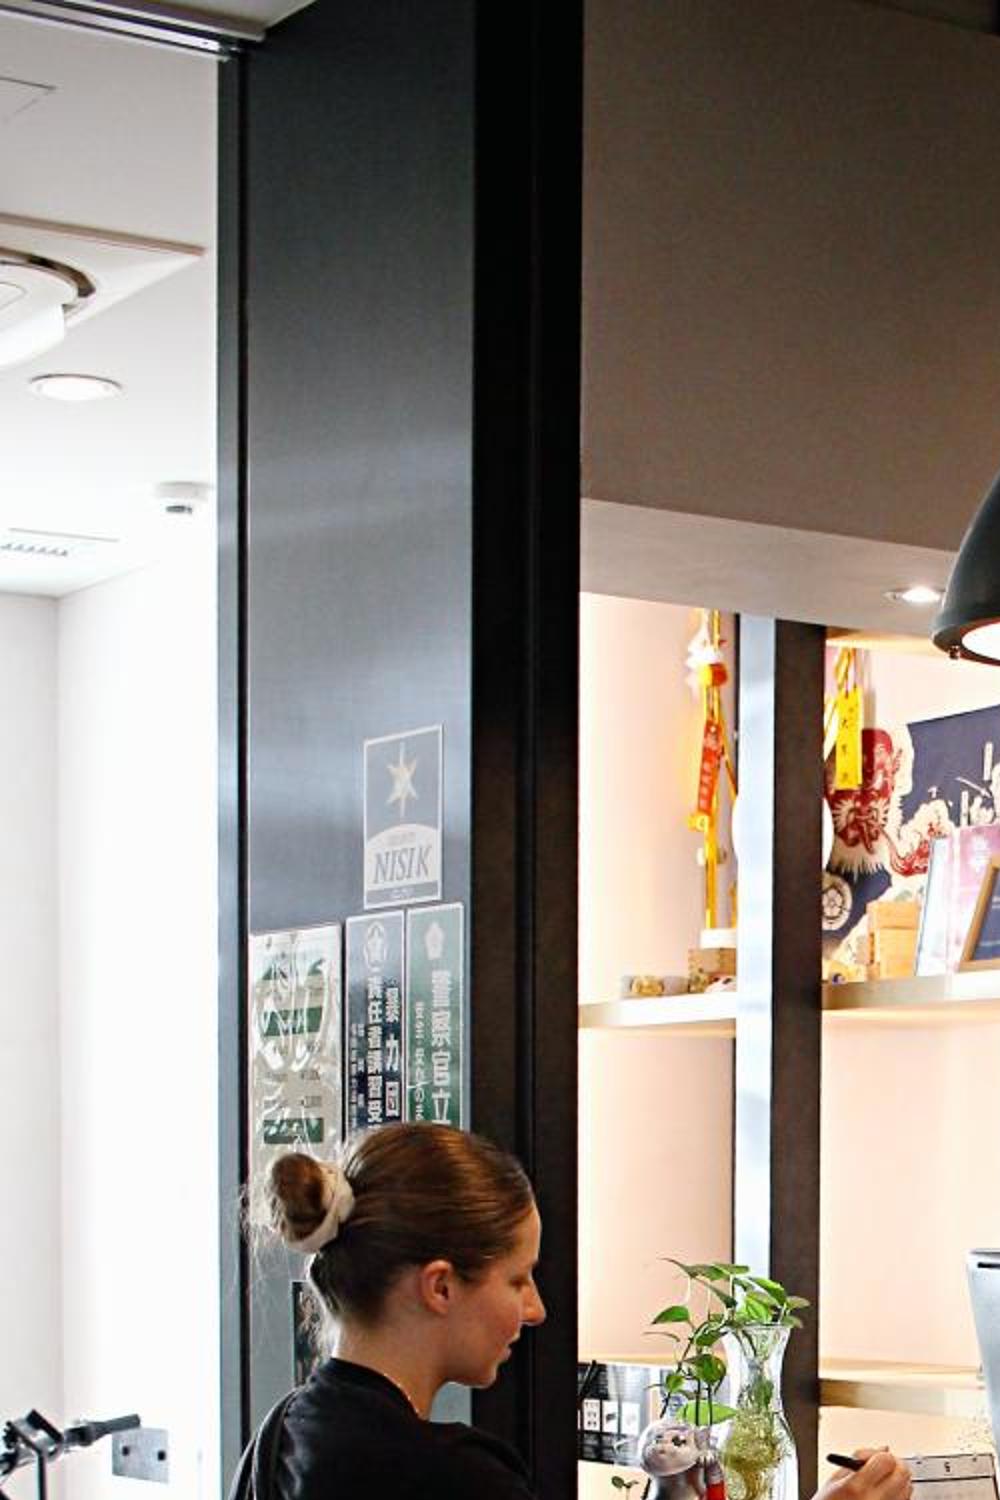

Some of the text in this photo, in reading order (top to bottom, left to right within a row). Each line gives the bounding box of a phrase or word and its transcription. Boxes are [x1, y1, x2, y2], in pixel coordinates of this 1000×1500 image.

[367, 976, 383, 1128] 責任者講習受
[385, 987, 399, 1117] 暴力団
